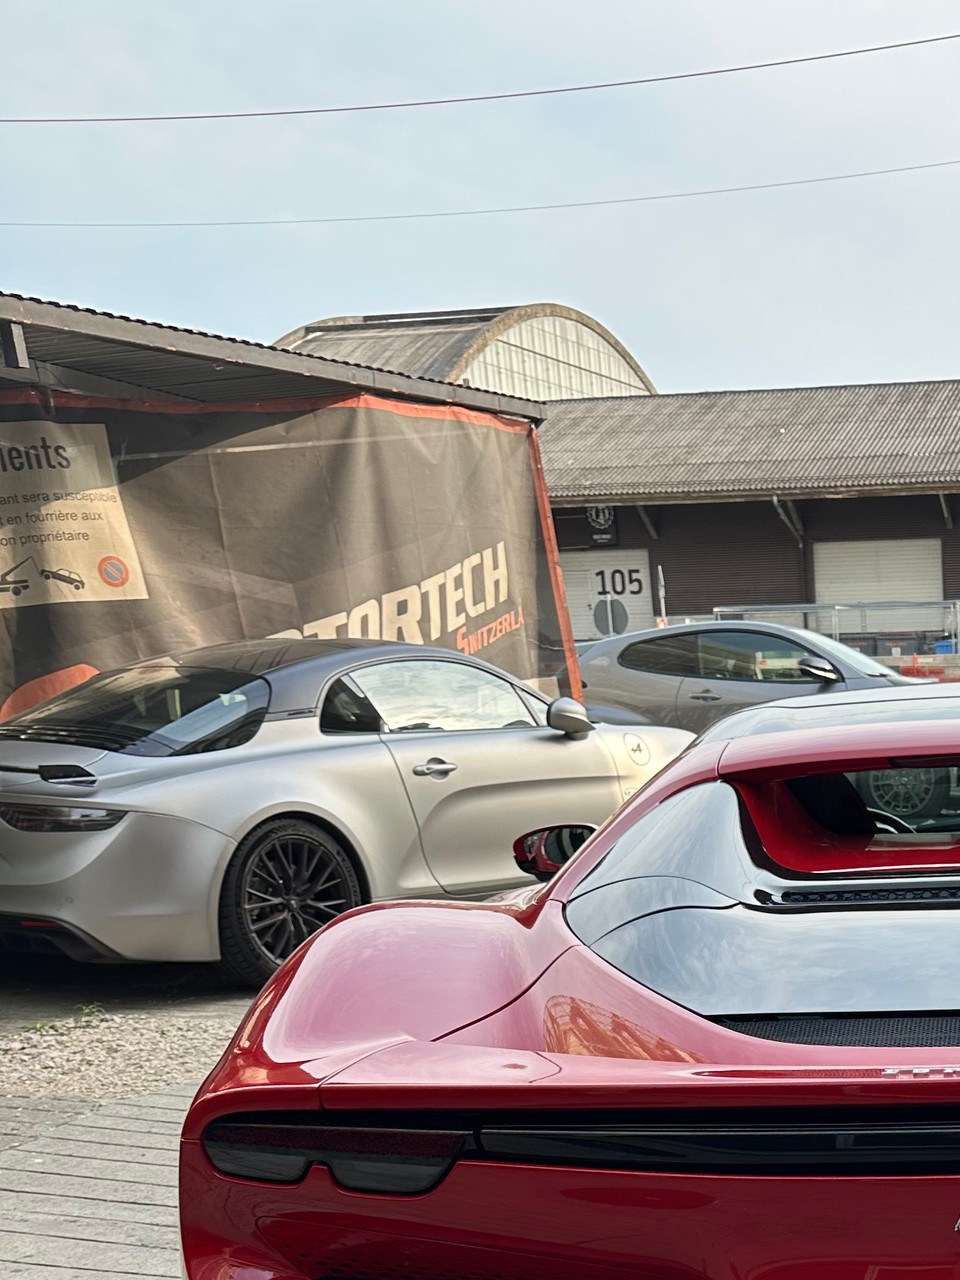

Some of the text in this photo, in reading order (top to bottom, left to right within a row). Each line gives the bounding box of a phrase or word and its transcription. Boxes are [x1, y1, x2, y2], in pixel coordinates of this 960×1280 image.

[22, 491, 49, 504] sera
[53, 490, 118, 504] susceptible
[7, 515, 22, 526] en
[25, 509, 78, 525] fourrière
[81, 511, 104, 521] aux
[19, 529, 90, 547] propriétaire
[595, 569, 643, 595] 105
